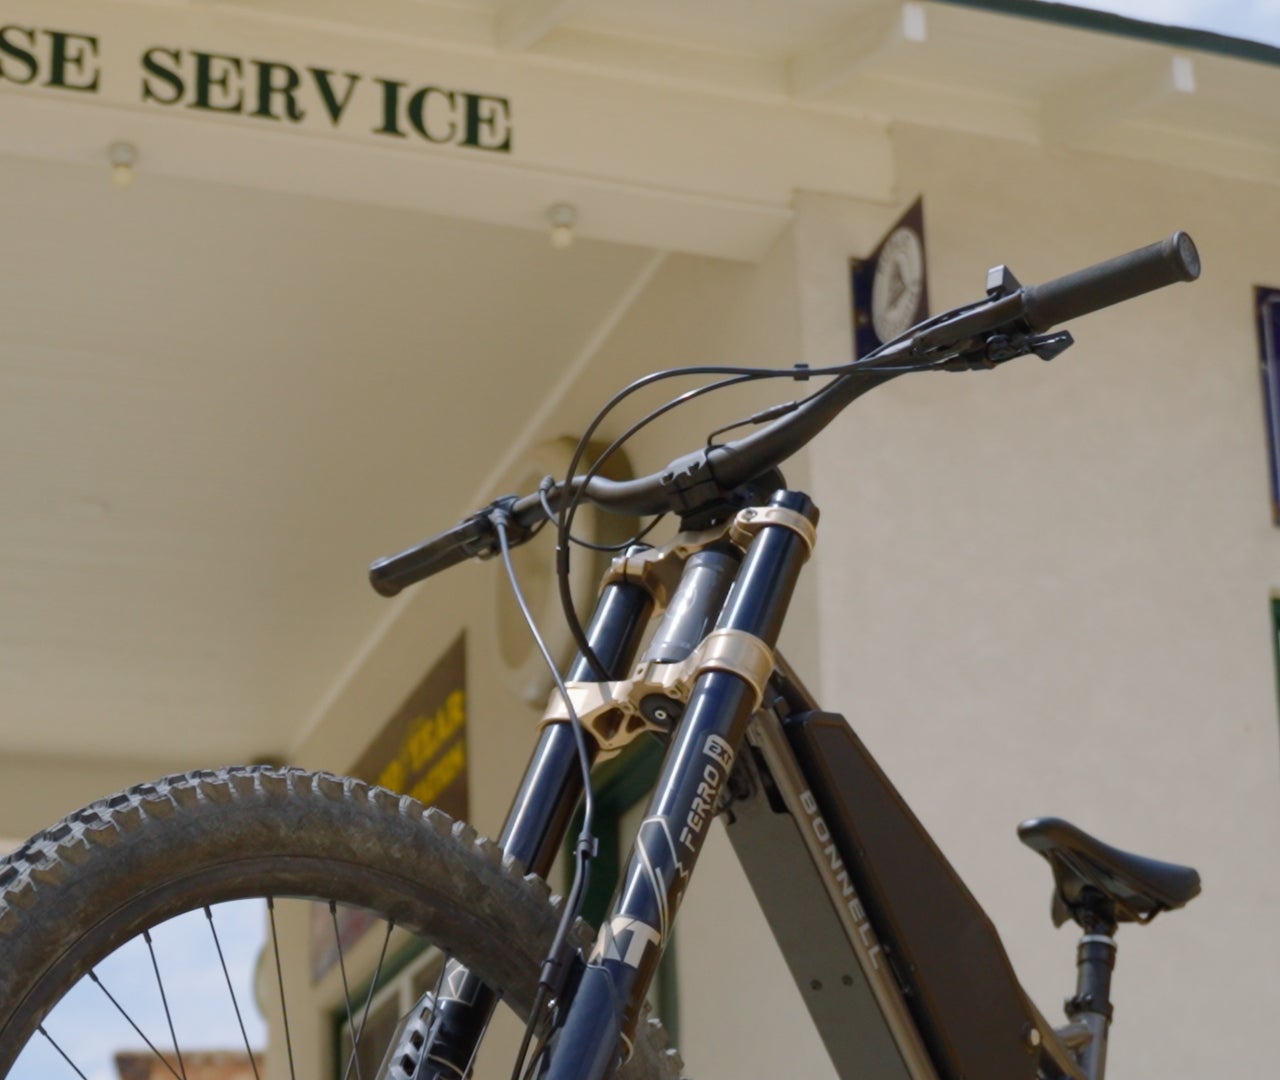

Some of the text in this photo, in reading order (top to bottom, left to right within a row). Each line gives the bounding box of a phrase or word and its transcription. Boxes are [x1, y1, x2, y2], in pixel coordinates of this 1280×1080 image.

[140, 46, 512, 153] SERVICE
[680, 764, 719, 852] FERRO
[799, 789, 880, 970] BONNELL
